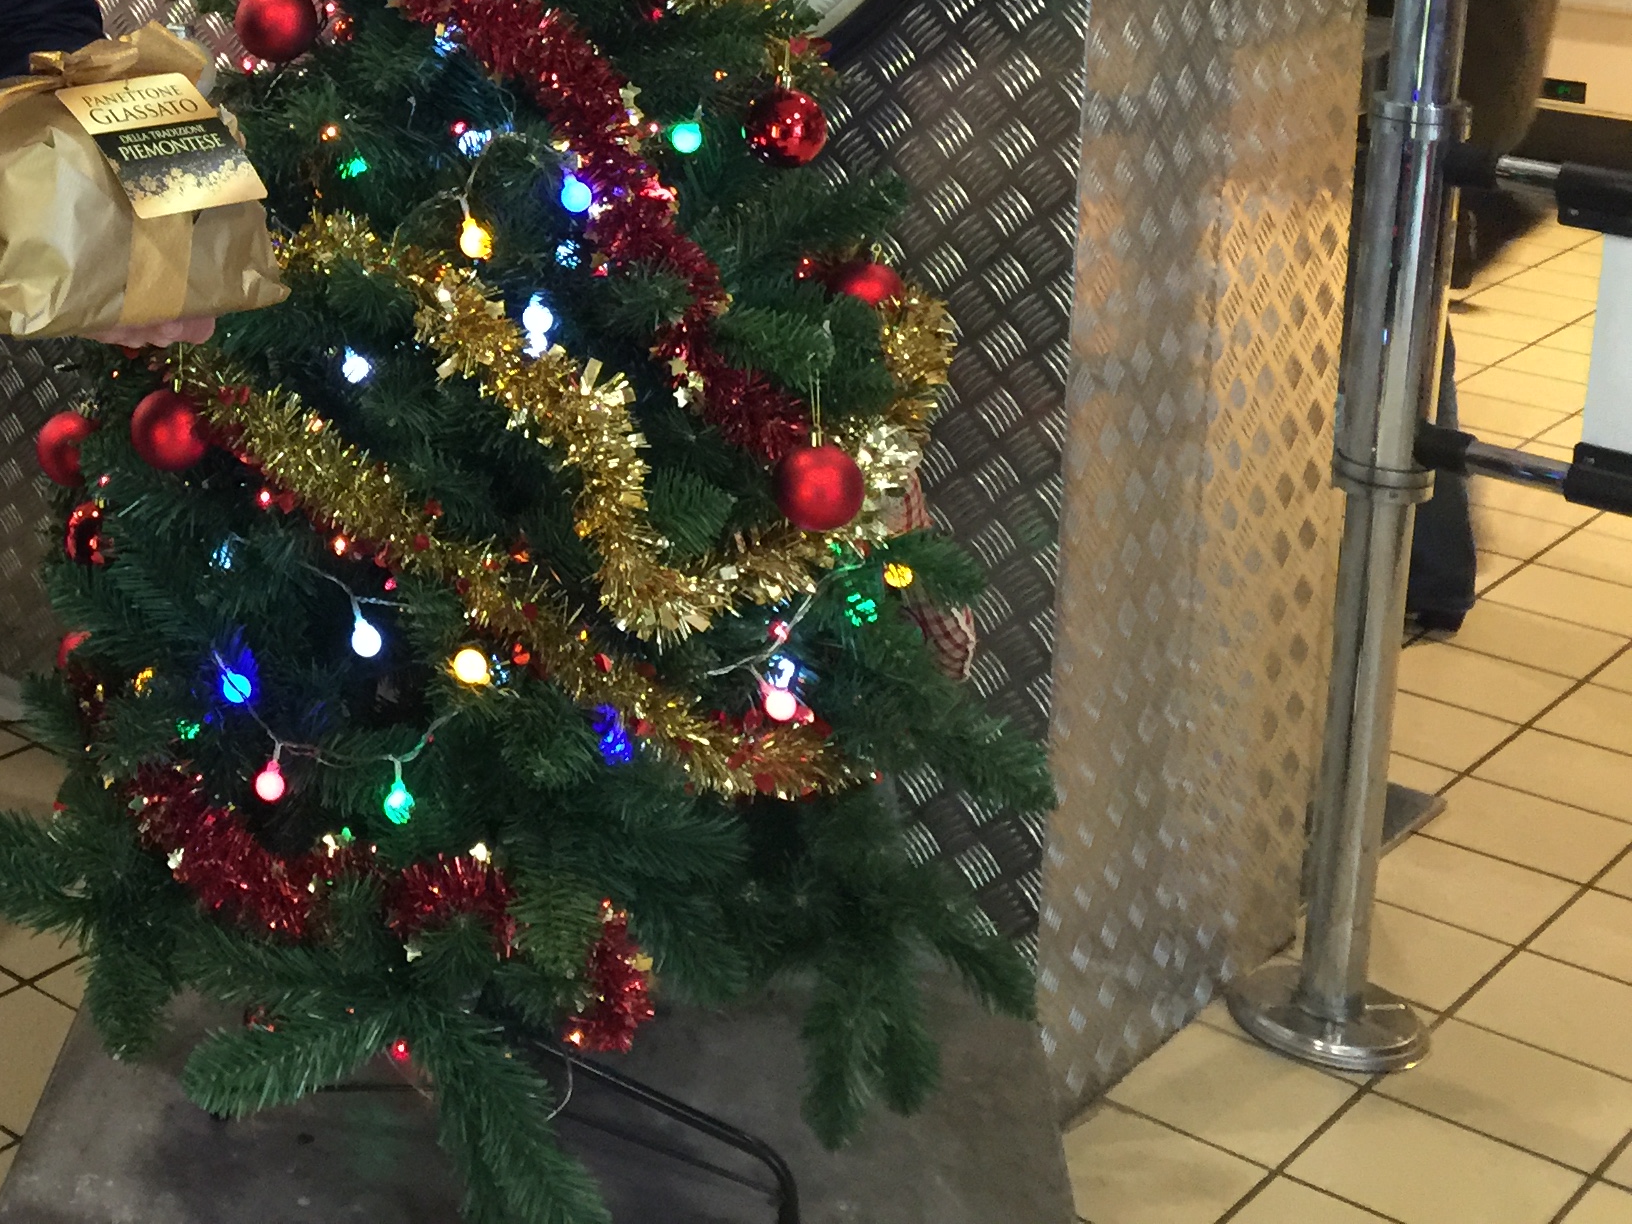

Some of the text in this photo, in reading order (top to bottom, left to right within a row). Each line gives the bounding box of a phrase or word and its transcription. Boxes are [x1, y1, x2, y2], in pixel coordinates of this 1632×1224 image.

[82, 84, 183, 108] PANETTONE
[89, 98, 198, 126] GLASSATO
[117, 133, 226, 162] PIEMONTESE
[119, 124, 207, 145] DELLA TRADIZIONE
